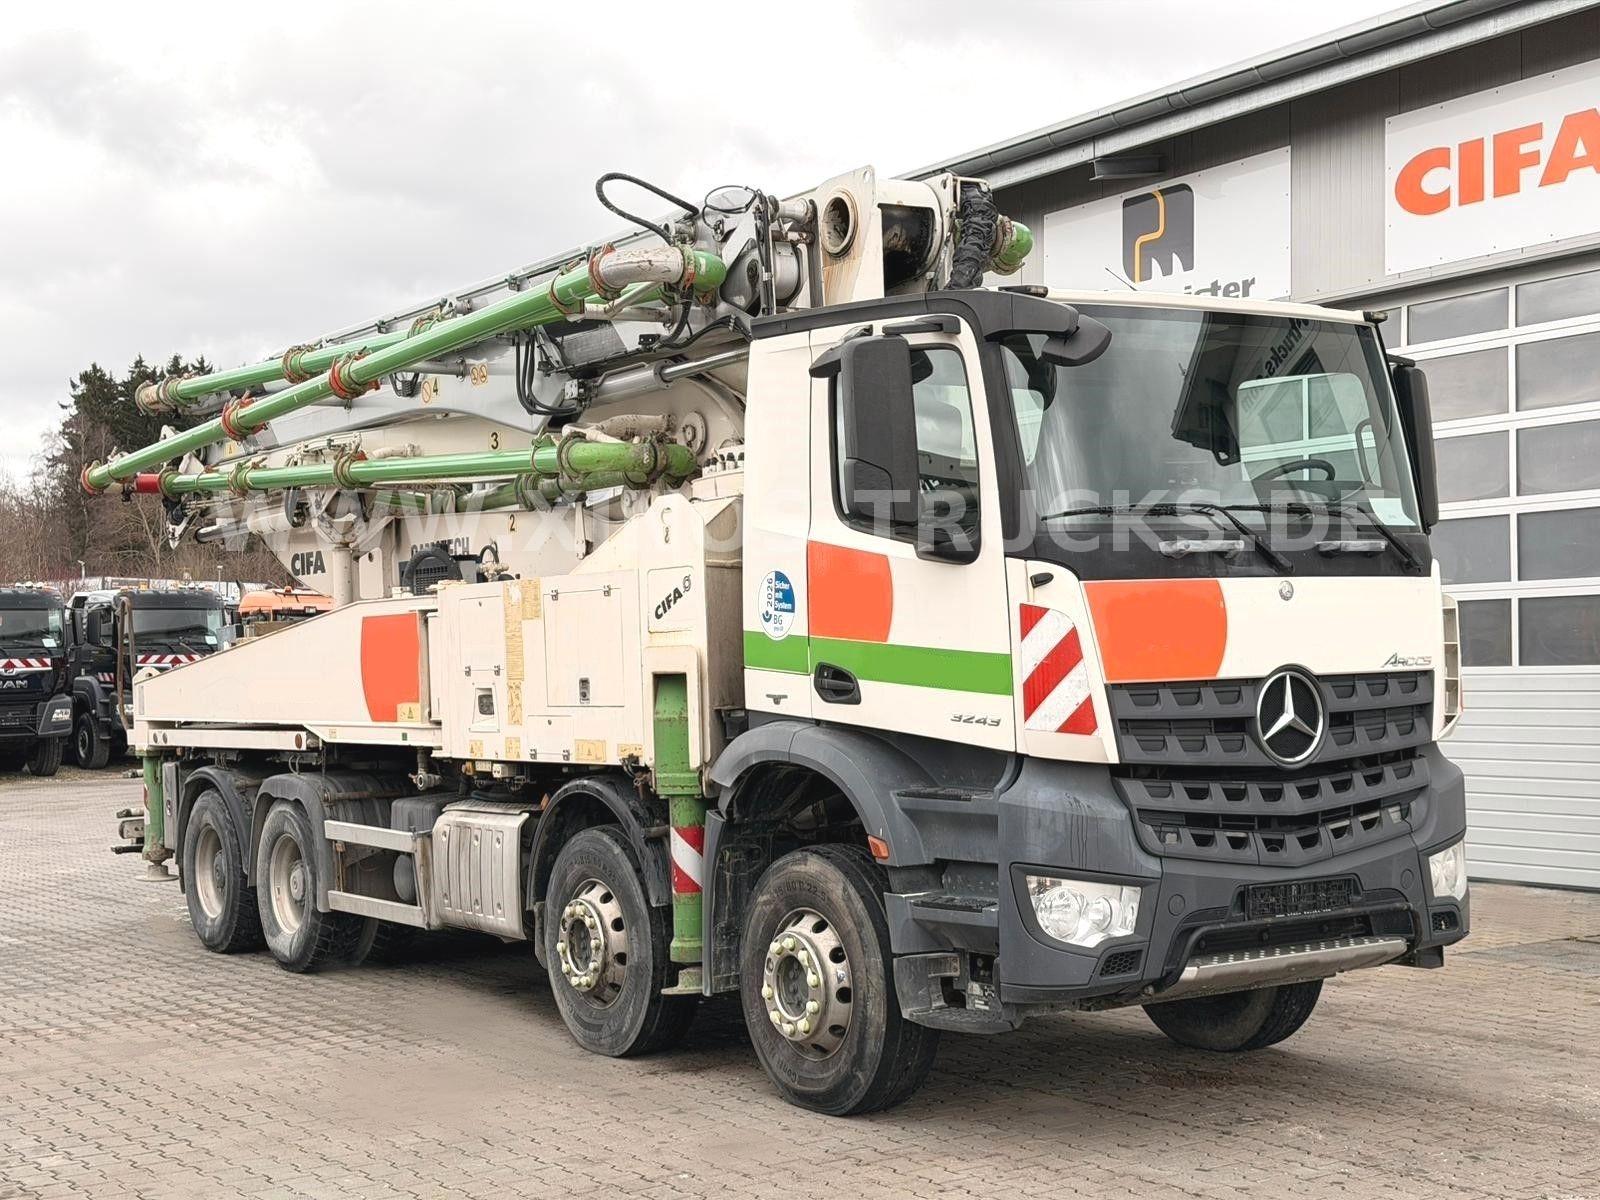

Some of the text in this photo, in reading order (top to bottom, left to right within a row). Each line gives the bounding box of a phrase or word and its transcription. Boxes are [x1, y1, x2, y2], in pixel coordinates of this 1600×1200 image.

[1394, 108, 1600, 216] CIFA
[432, 377, 439, 396] 4
[490, 431, 499, 450] 3
[509, 514, 516, 533] 2
[291, 550, 326, 577] CIFA
[654, 587, 683, 620] CIFA
[773, 614, 783, 625] BG
[0, 679, 28, 688] AN
[950, 713, 1001, 727] 3243
